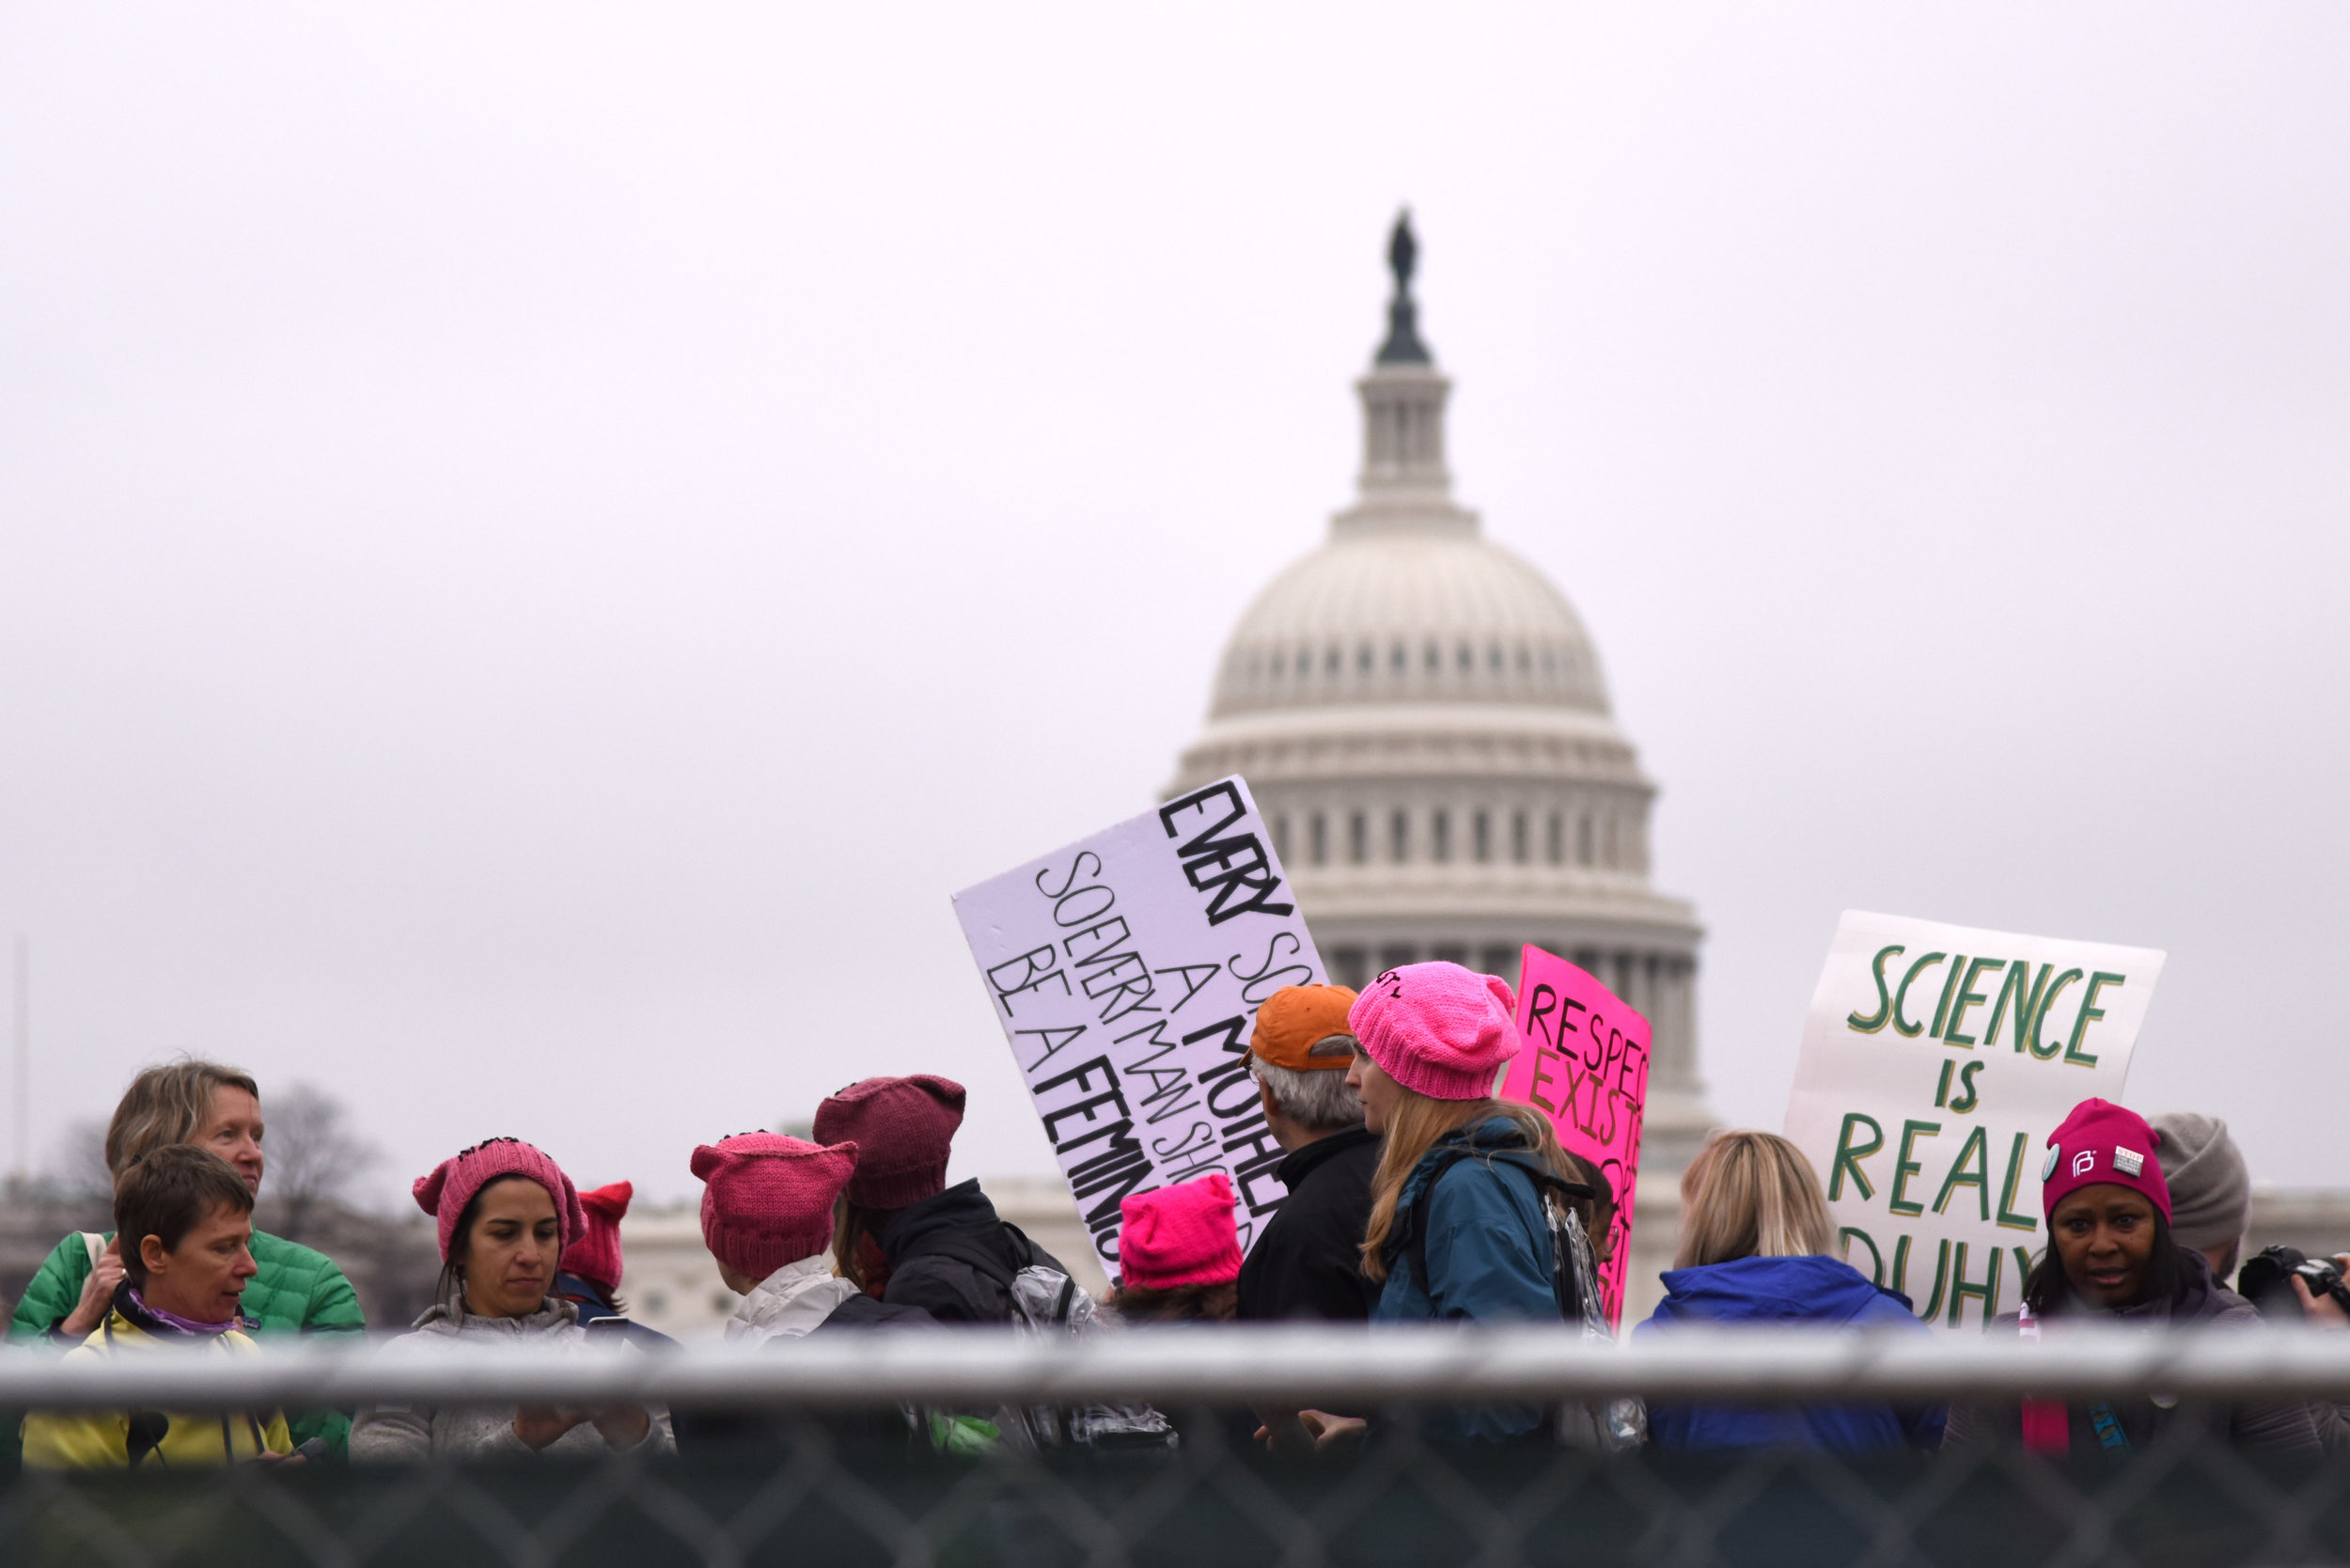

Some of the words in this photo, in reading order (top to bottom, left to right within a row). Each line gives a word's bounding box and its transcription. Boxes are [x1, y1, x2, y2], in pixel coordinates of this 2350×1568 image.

[1159, 780, 1293, 926] EVERY
[1229, 932, 1312, 1015] SO
[987, 944, 1072, 1017] BE
[1154, 964, 1221, 1013] A
[1847, 945, 2126, 1068] SCIENCE
[1015, 1025, 1088, 1073] A
[1113, 1020, 1199, 1124] MAN
[1527, 984, 1649, 1112] RESPEC
[1934, 1058, 1984, 1114] IS
[1182, 1014, 1290, 1218] MOHE
[1828, 1112, 2038, 1231] REAL
